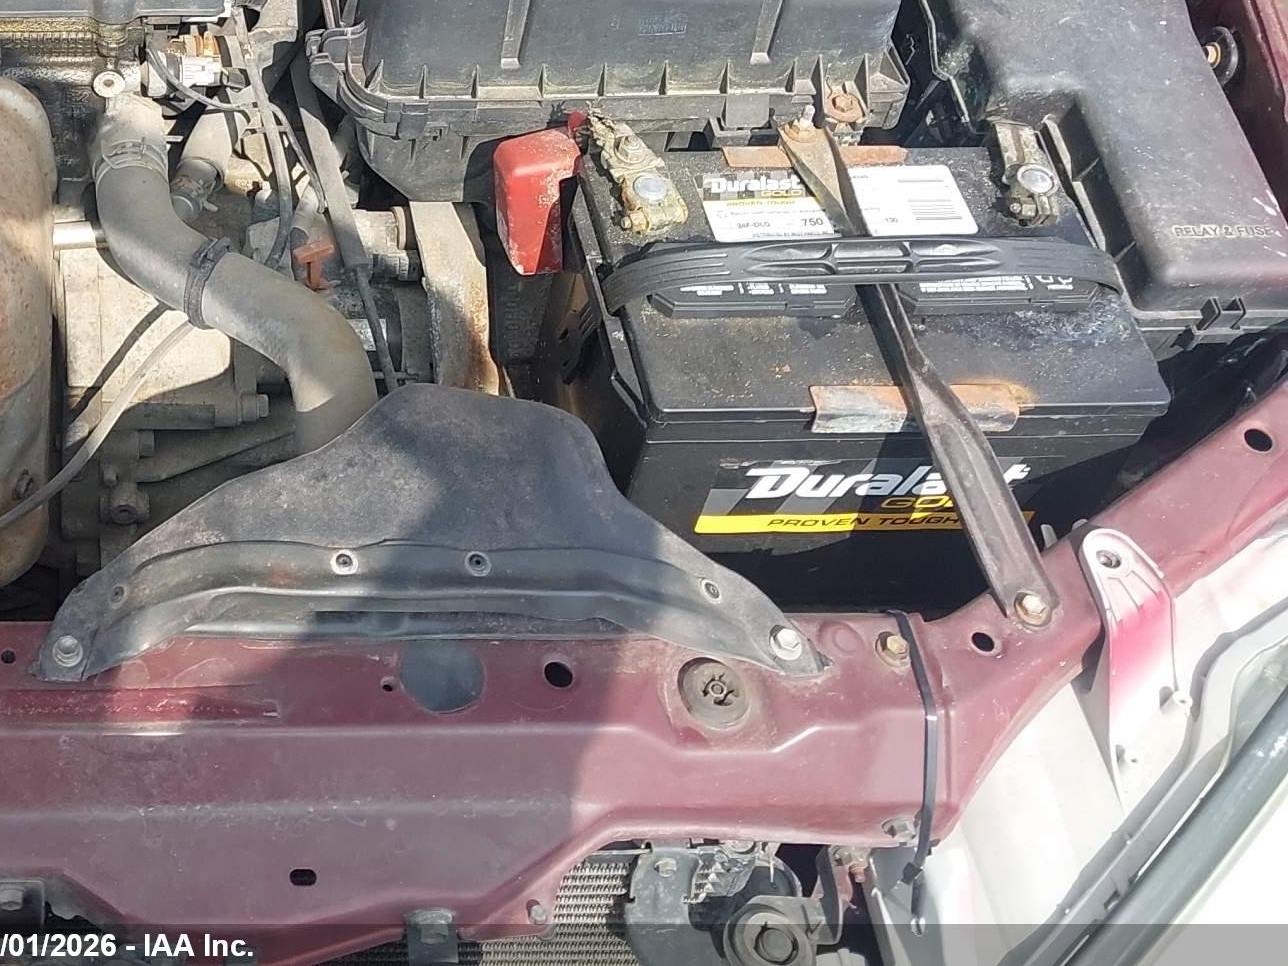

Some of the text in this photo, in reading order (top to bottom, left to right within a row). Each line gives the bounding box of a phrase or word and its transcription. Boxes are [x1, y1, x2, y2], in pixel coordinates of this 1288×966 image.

[702, 172, 801, 193] Duralast
[760, 188, 803, 198] GOLD
[801, 217, 824, 227] 750
[1173, 225, 1219, 238] RELAY
[1236, 225, 1273, 237] FUSE
[745, 464, 1031, 500] Duralat
[880, 495, 954, 509] GO
[768, 514, 960, 528] PROVEN TOUGH
